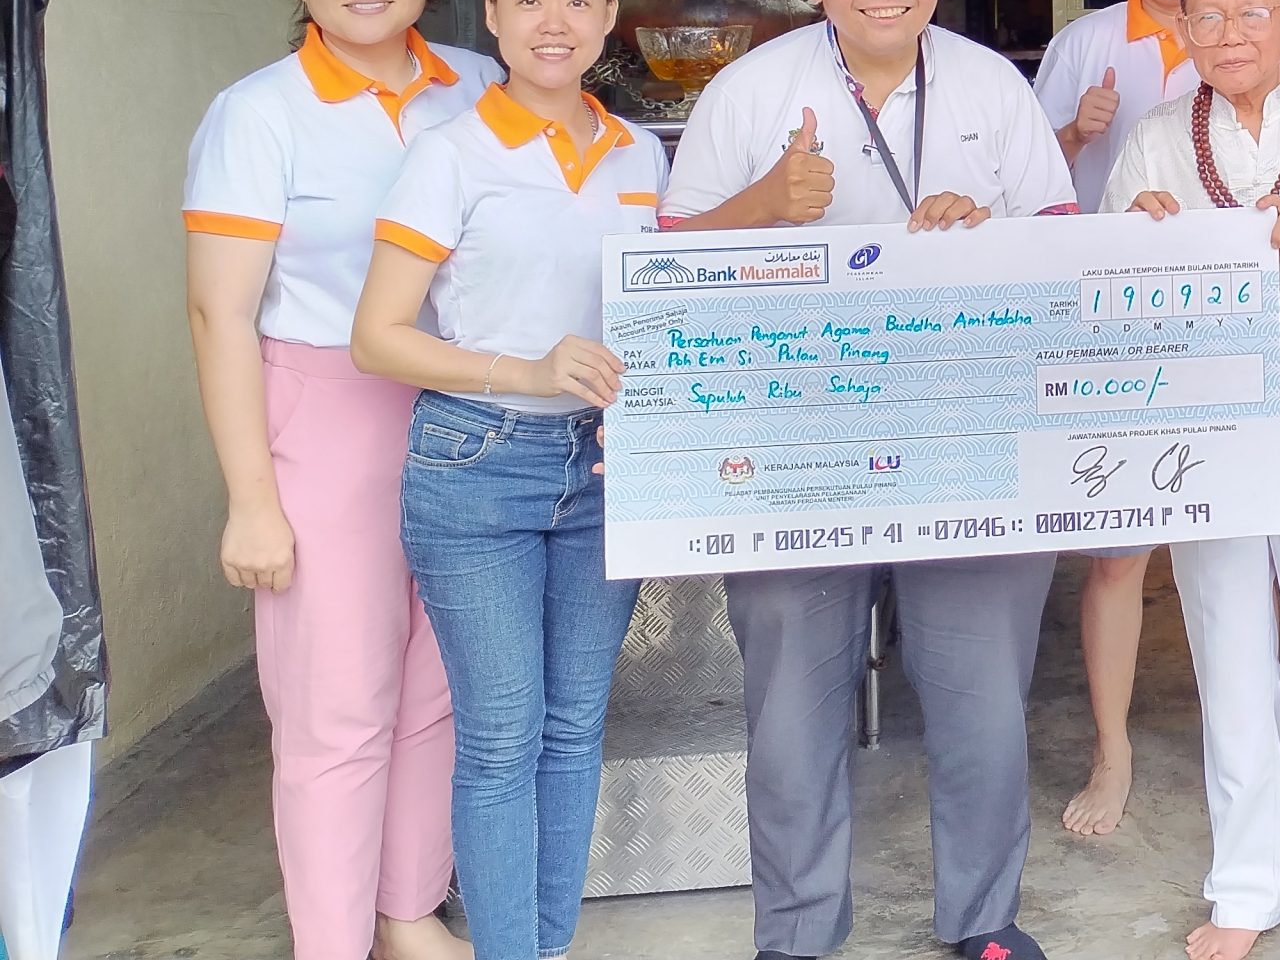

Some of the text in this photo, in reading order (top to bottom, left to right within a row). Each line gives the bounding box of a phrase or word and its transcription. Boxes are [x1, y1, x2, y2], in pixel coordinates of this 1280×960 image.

[960, 132, 979, 142] CHAN
[696, 262, 821, 283] Bank Muamalat
[1082, 261, 1259, 277] LAKU DALAM TEMPOH ENAM BULAN DARI TARIKH
[1050, 299, 1079, 308] TARIKH
[1094, 281, 1251, 313] 1 9 0 9 2 6
[610, 323, 632, 332] Akaun
[665, 308, 688, 318] Sahaja
[1050, 308, 1071, 317] DATE
[618, 317, 684, 338] Account Payee Only
[667, 308, 1033, 349] Persatuan Penganut Agama Buddha Amitabha
[1093, 316, 1254, 334] D D M M Y Y
[623, 350, 643, 359] PAY
[668, 351, 692, 369] Poh
[738, 349, 752, 366] Si
[778, 343, 819, 363] Pulau
[840, 342, 890, 365] Pinang
[1035, 349, 1064, 360] ATAU
[1066, 347, 1120, 359] PEMBAWA
[1127, 345, 1144, 356] OR
[1145, 343, 1190, 354] BEARER
[624, 360, 656, 370] BAYAR
[624, 387, 664, 397] RINGGIT
[688, 382, 747, 414] Sepuluh
[767, 380, 803, 400] Ribu
[1045, 382, 1068, 397] RM
[1067, 424, 1237, 441] JAWATANKUASA PROJEK KHAS PULAU PINANG
[764, 459, 860, 472] KERAJAAN MALAYSIA
[724, 489, 752, 497] PEJABAT
[753, 487, 805, 495] PEMBANGUNAAN
[821, 489, 867, 497] PELAKSANAAN
[775, 527, 854, 551] 001245
[883, 523, 904, 544] 41
[934, 516, 1006, 541] 07046
[1036, 507, 1154, 534] 0001273714
[1184, 503, 1211, 524] 99
